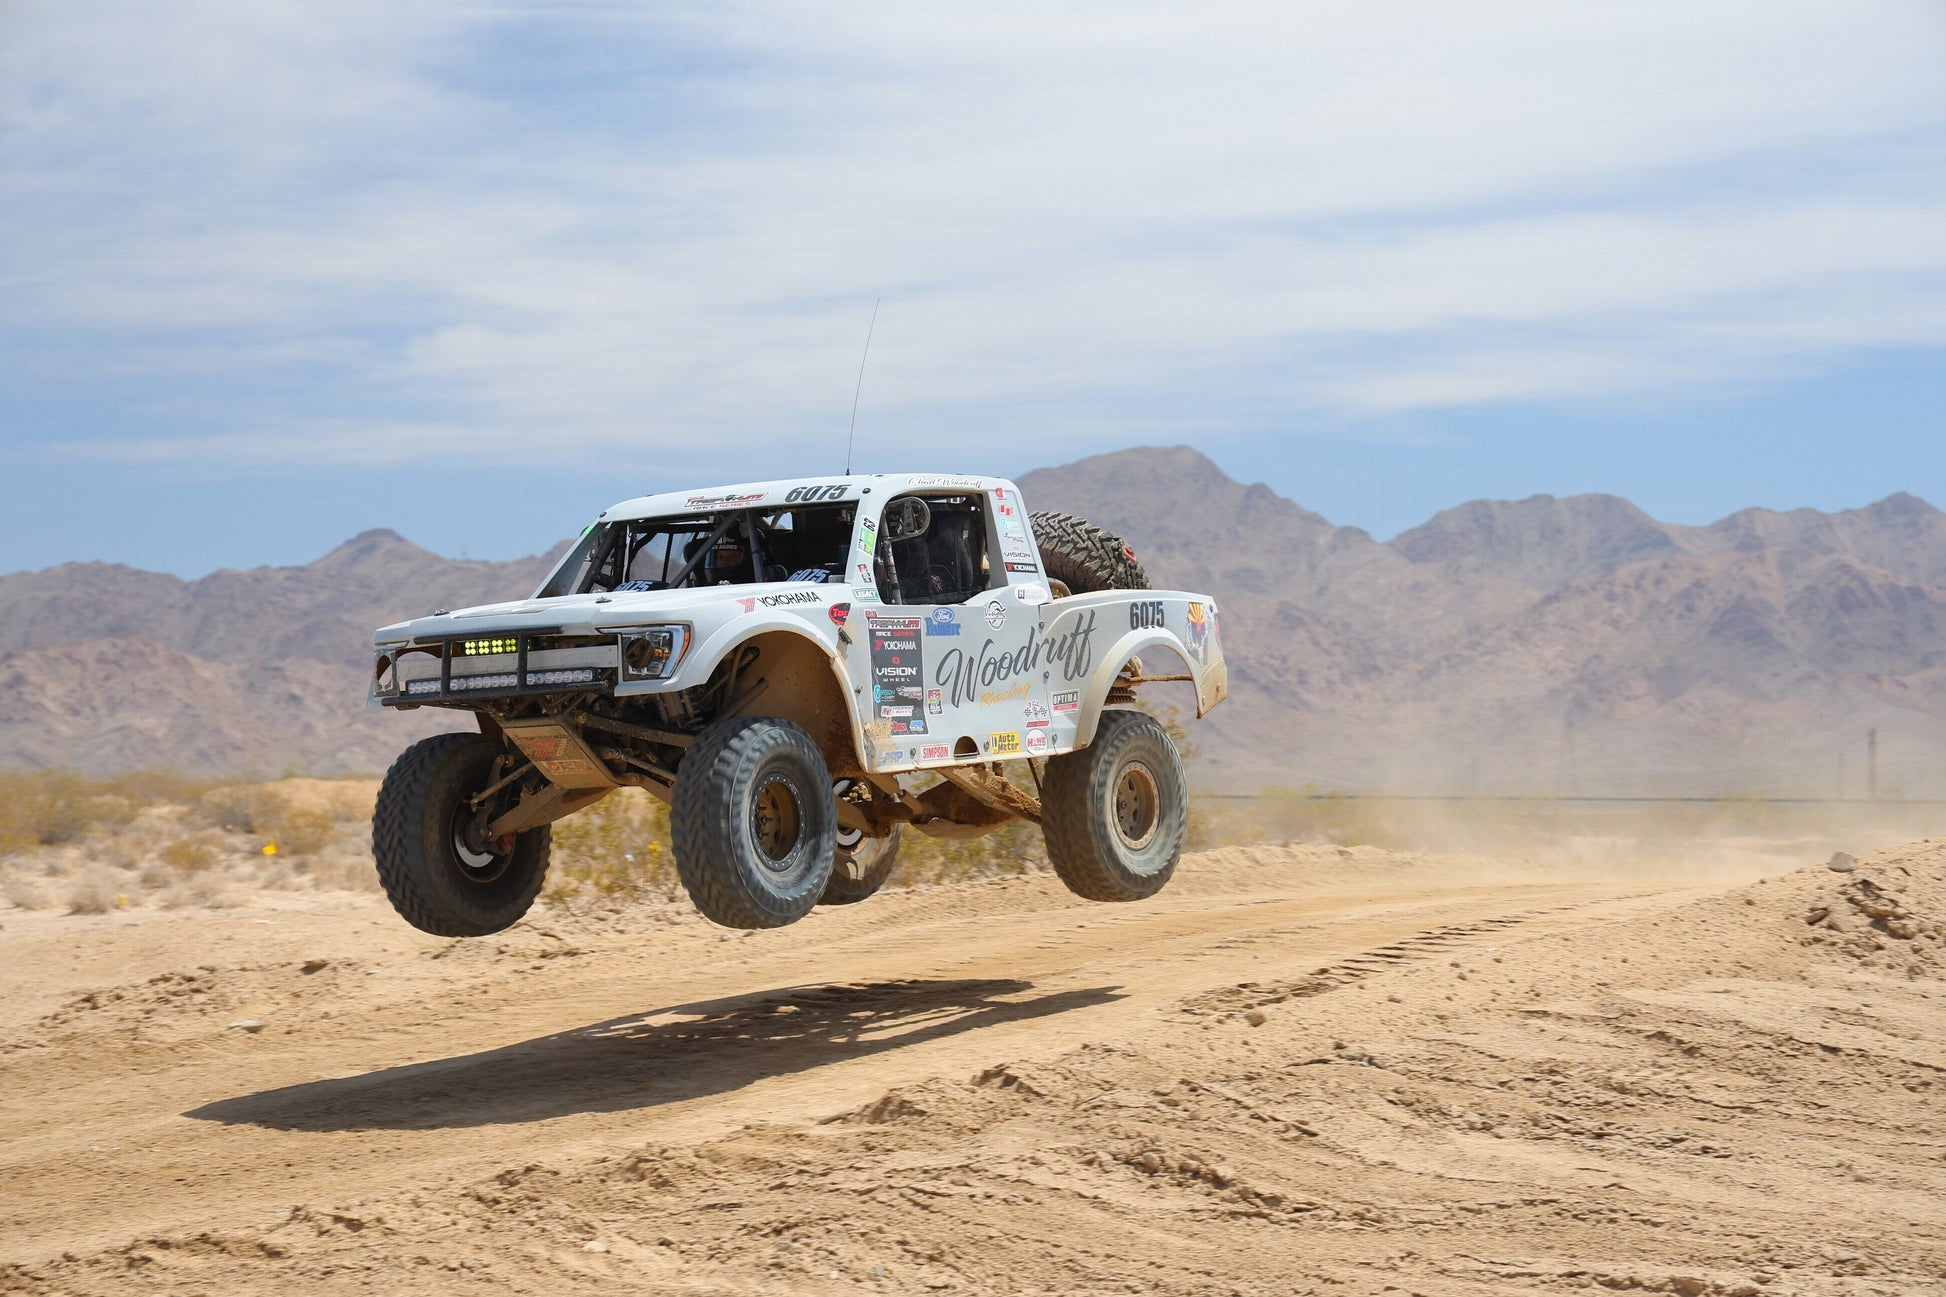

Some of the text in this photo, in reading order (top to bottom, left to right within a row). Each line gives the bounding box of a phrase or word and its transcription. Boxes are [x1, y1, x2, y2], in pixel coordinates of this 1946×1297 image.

[937, 478, 983, 489] Woodruff
[785, 484, 852, 502] 6075
[757, 591, 823, 607] YOKOHAMA
[855, 590, 877, 598] LEGACY
[1129, 601, 1165, 630] 6075
[883, 640, 918, 650] YOKOHAMA
[935, 609, 1097, 708] Woodruff
[875, 667, 917, 676] VISION
[1053, 692, 1079, 706] OPTIMA
[998, 734, 1017, 743] Auto
[922, 745, 950, 760] SIMPSON
[998, 742, 1020, 752] Meter
